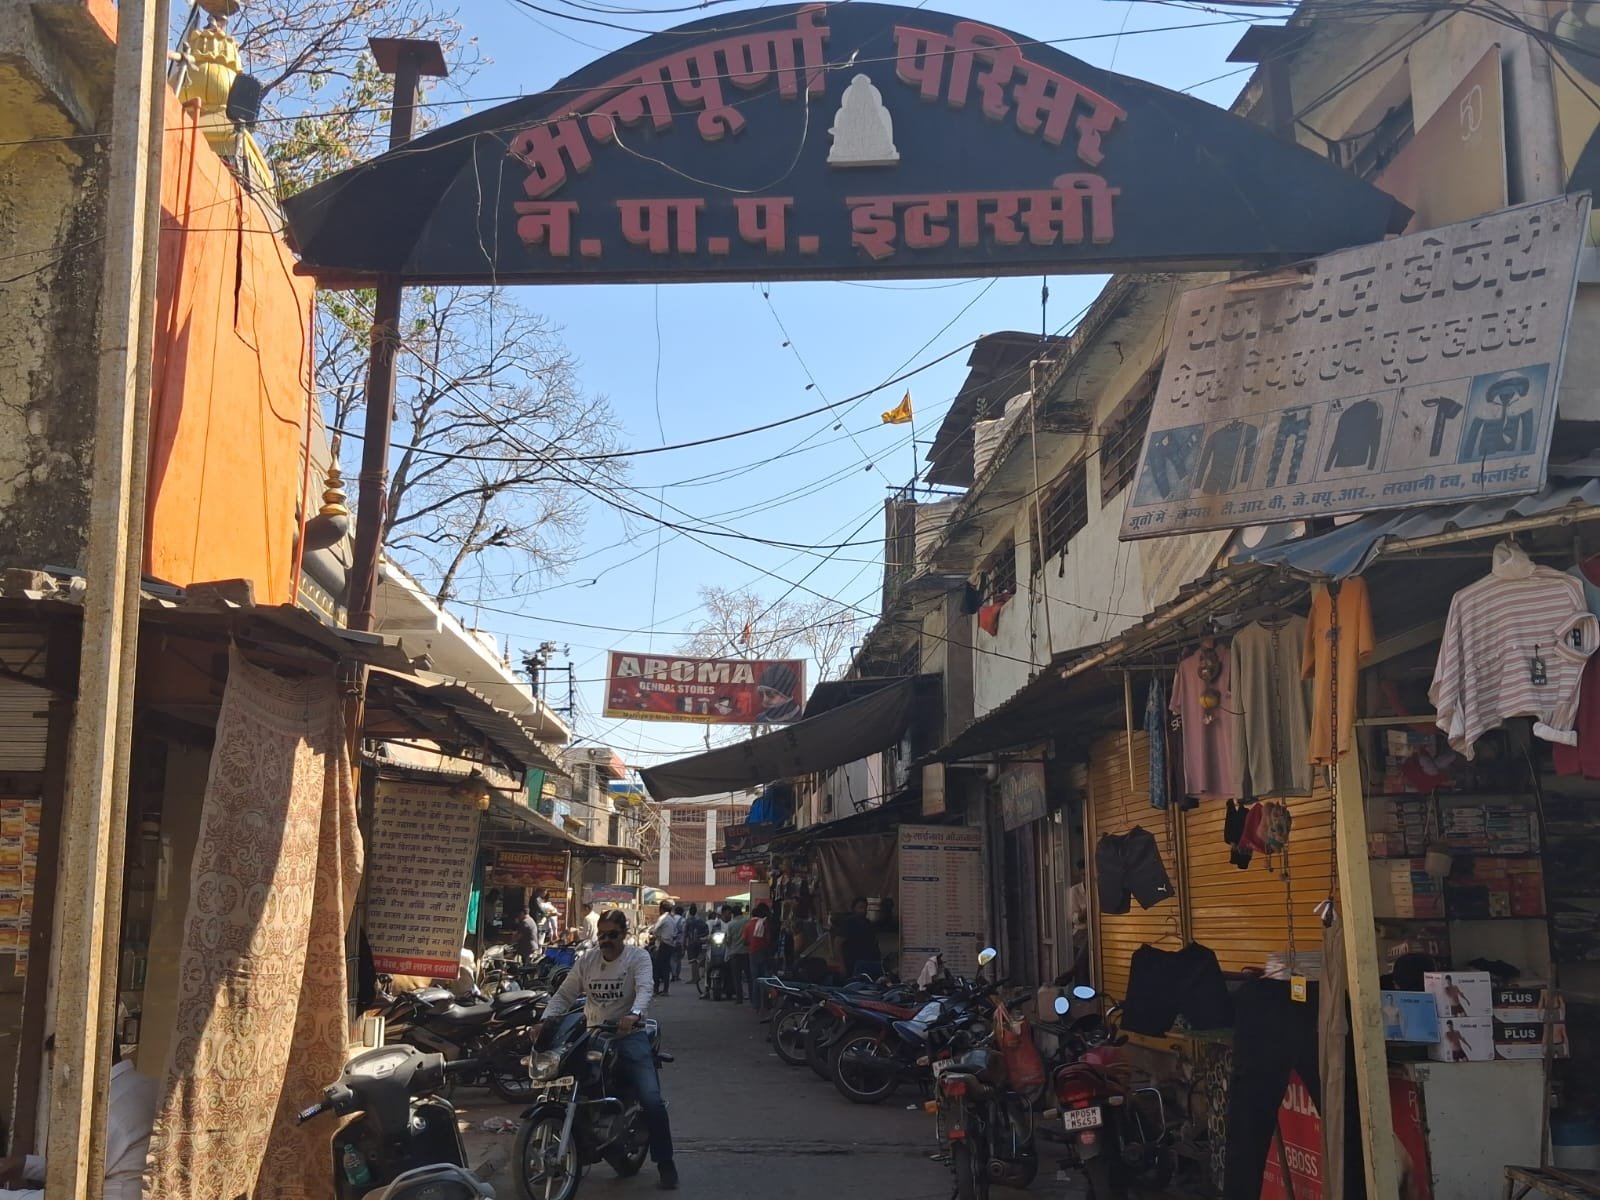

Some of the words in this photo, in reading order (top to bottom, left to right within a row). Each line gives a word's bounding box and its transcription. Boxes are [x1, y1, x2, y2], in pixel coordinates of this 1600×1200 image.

[507, 2, 832, 199] अन्नपूर्णा
[893, 20, 1128, 166] परिसर
[846, 173, 1122, 261] इटारसी
[617, 656, 755, 684] AROMA
[678, 684, 716, 696] STORES
[1501, 993, 1533, 1004] PLUS
[1504, 1028, 1536, 1040] PLUS
